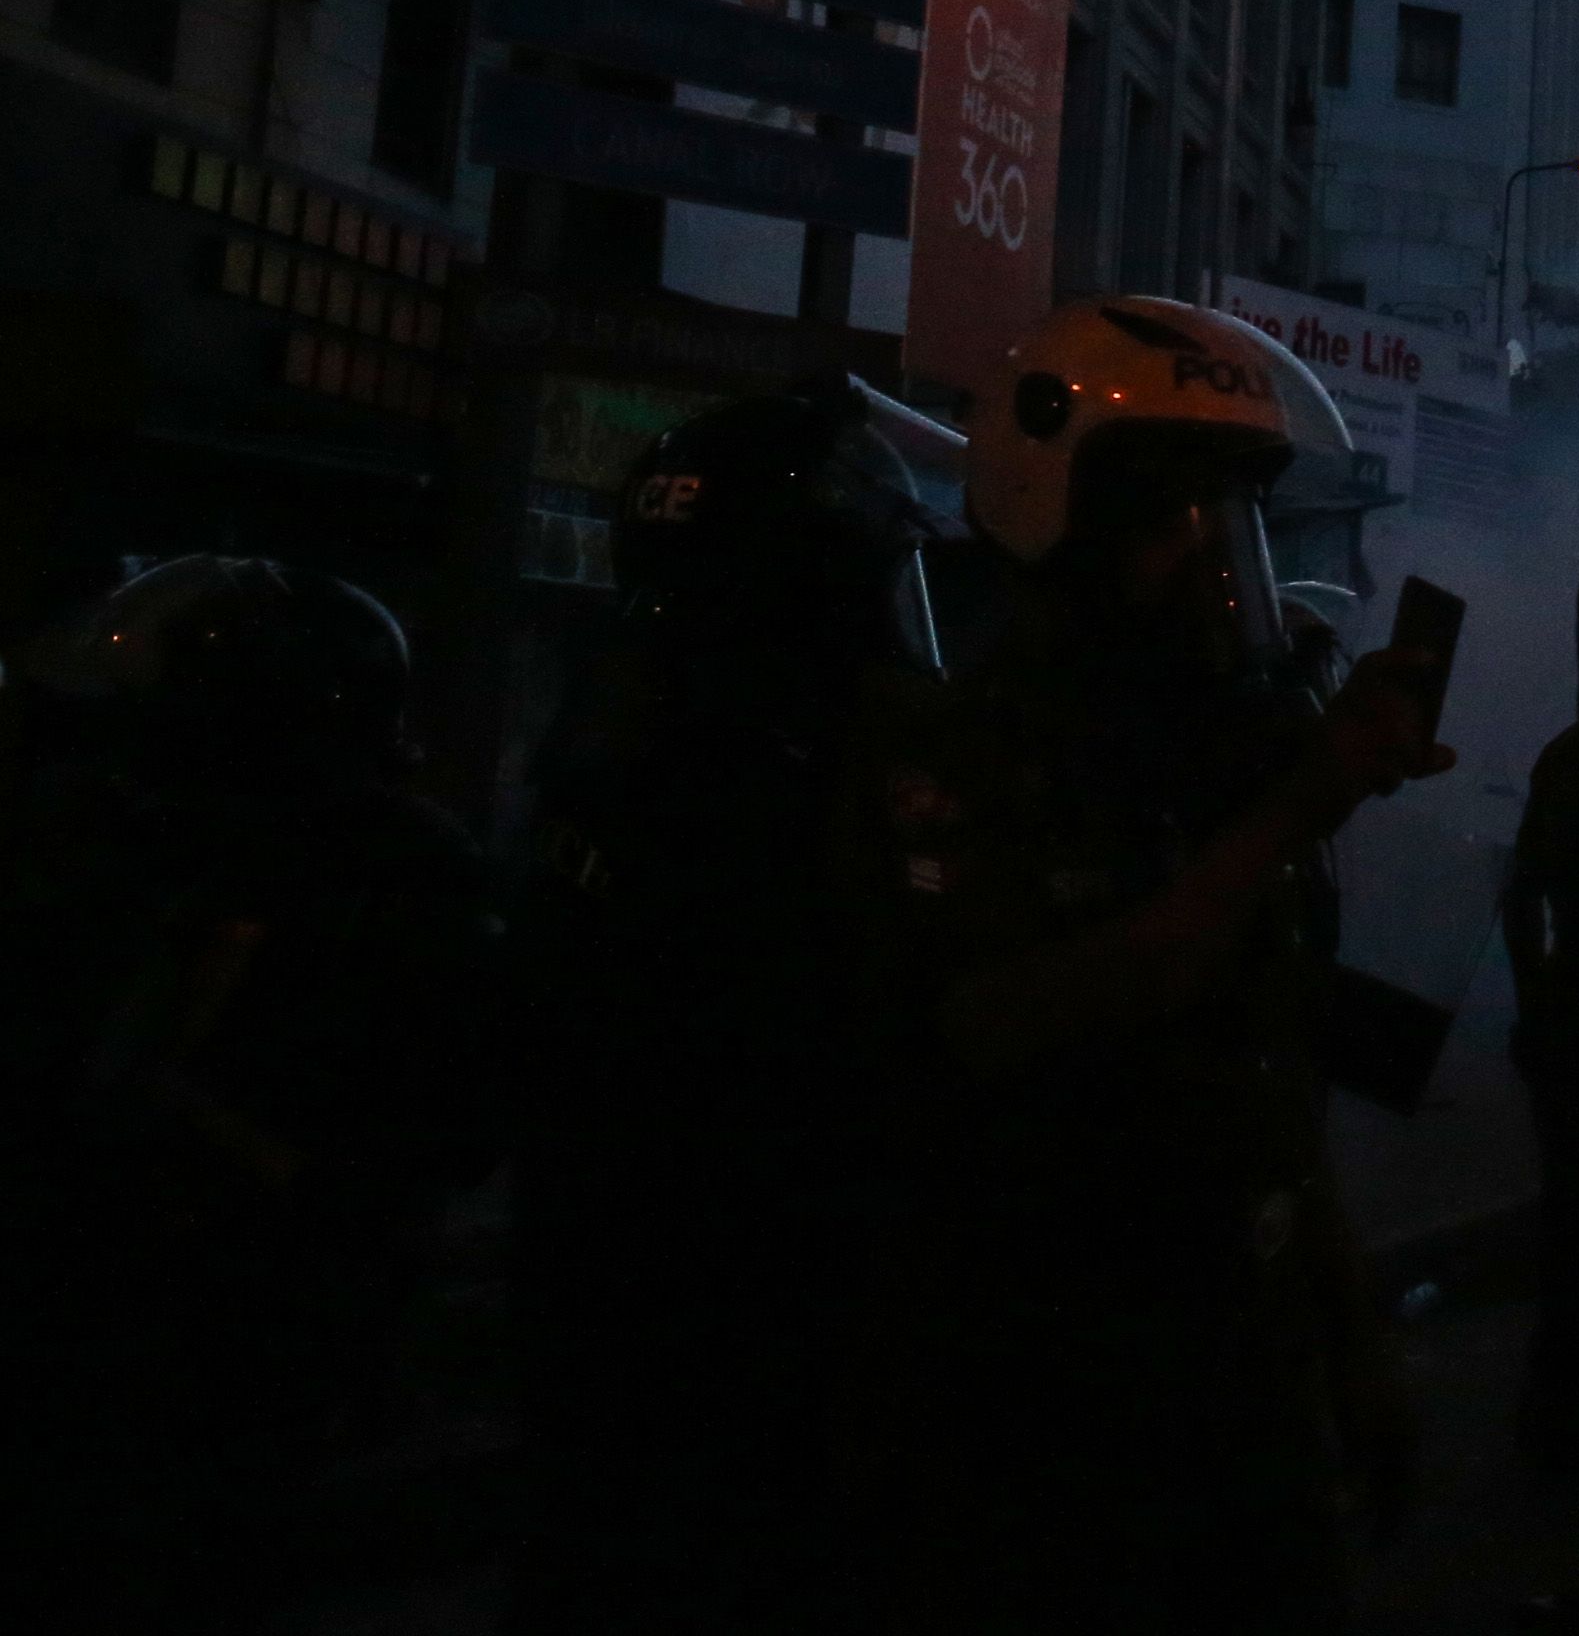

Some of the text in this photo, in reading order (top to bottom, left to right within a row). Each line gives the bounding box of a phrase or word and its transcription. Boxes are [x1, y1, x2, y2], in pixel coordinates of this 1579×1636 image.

[573, 113, 838, 200] CANAL ROW
[961, 84, 1034, 158] HEALTH
[954, 135, 1029, 252] 360
[1292, 315, 1349, 367] the
[1361, 330, 1422, 384] Life
